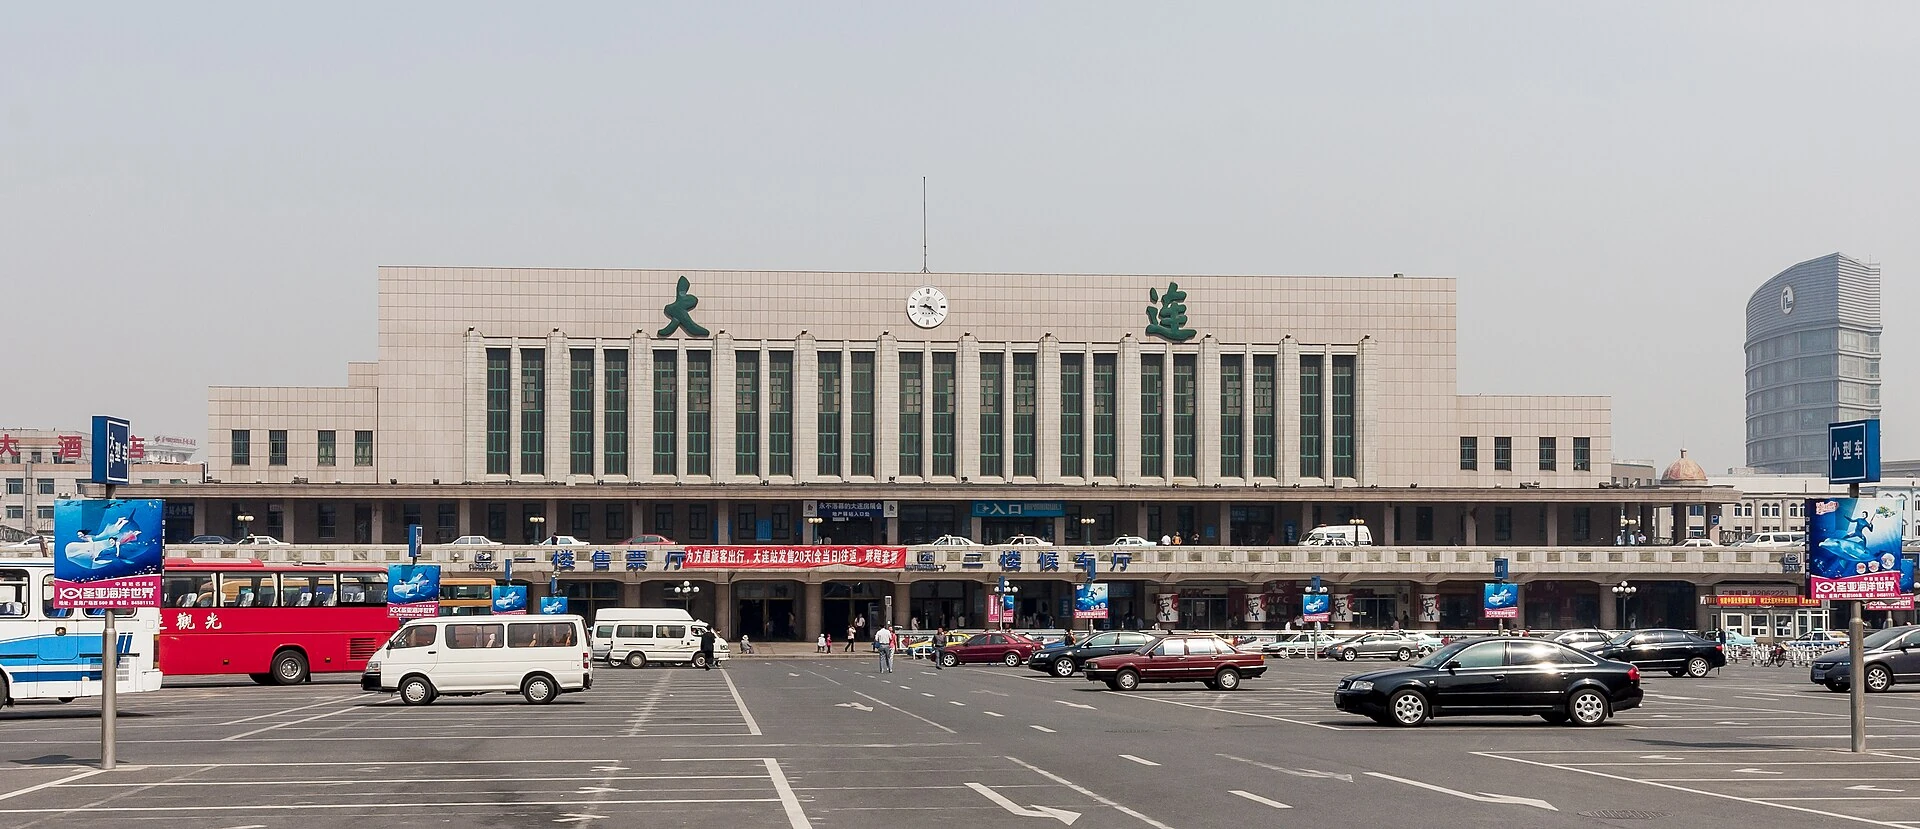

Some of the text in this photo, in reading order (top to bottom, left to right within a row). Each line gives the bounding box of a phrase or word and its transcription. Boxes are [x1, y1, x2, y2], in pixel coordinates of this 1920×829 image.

[658, 275, 1197, 343] 大 连
[1832, 440, 1863, 461] 小型车
[989, 503, 1021, 515] 入口
[512, 550, 684, 571] 一楼售票厅
[83, 587, 154, 599] 圣亚海洋世界
[1836, 581, 1895, 593] 圣亚海洋世界
[1267, 596, 1289, 604] KFC
